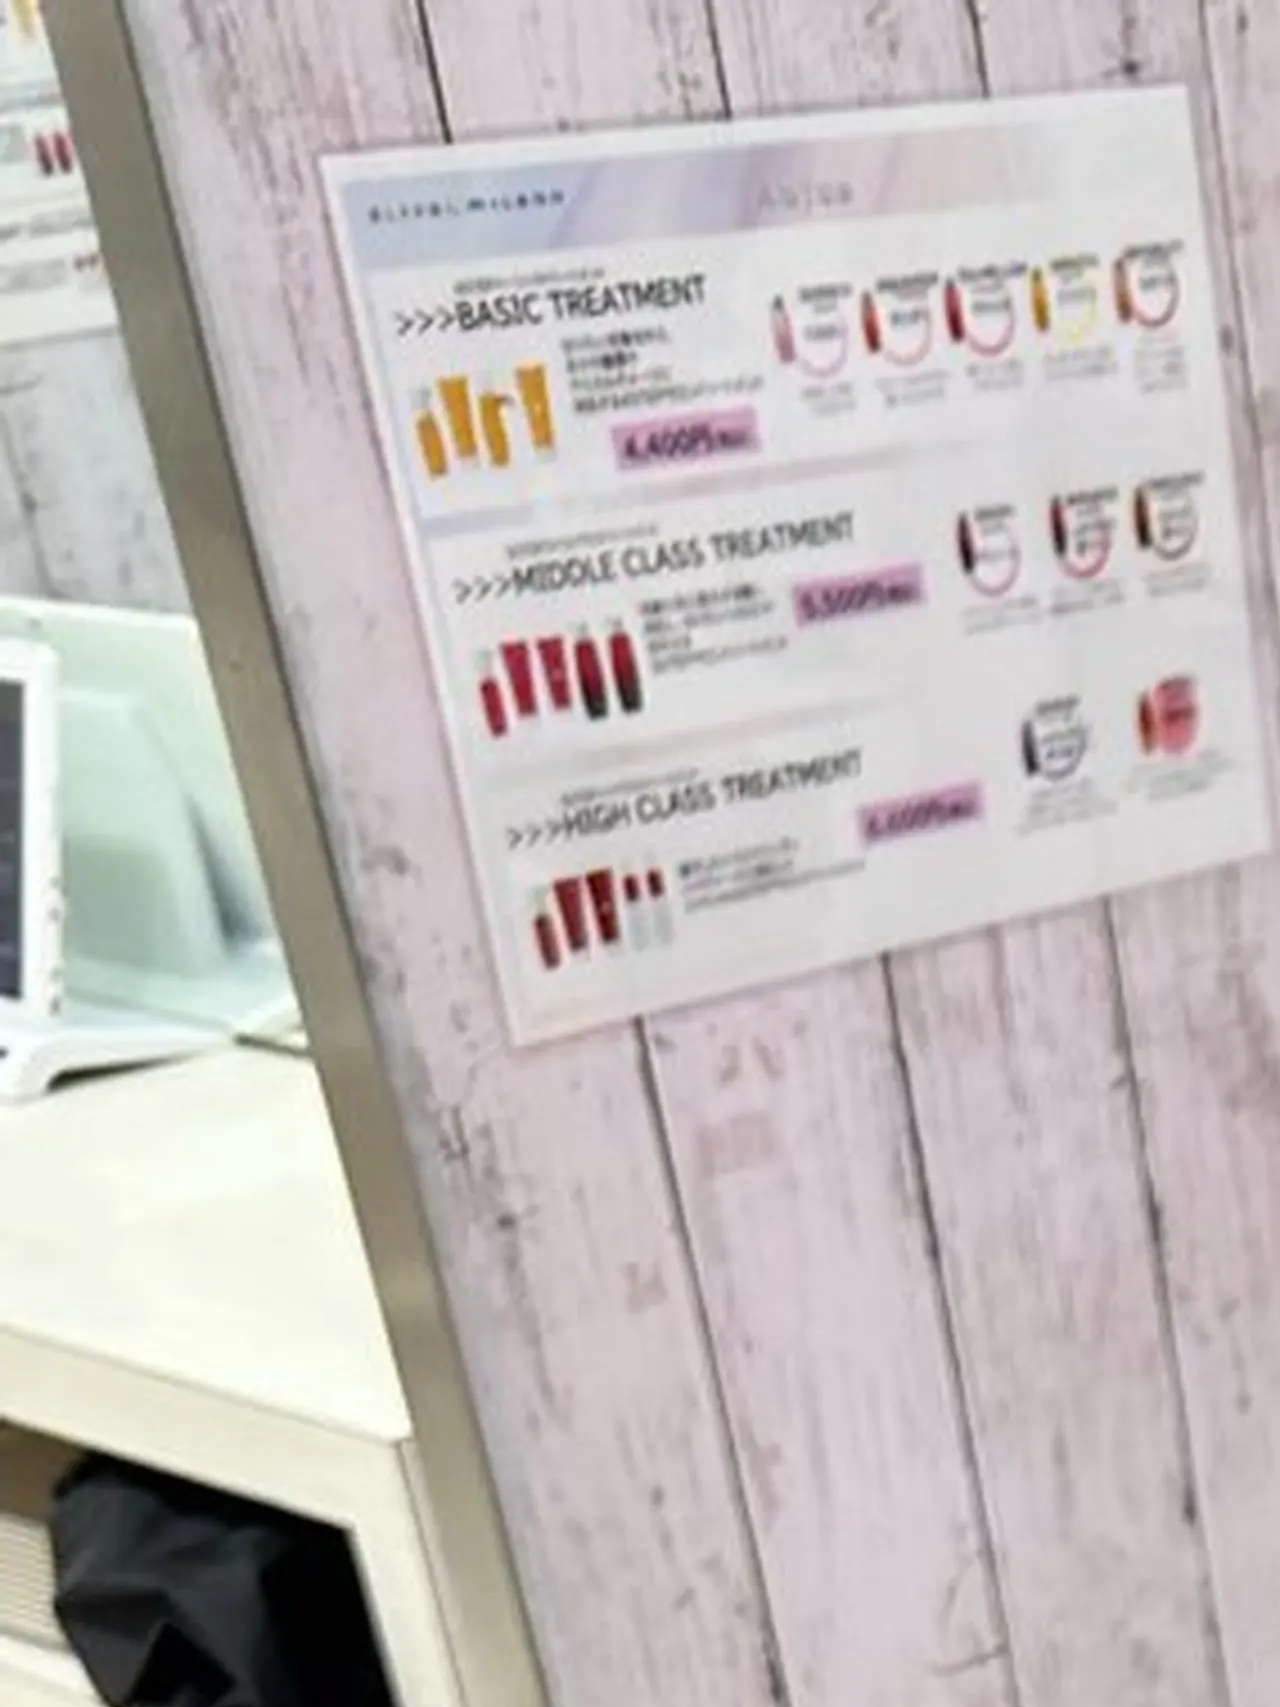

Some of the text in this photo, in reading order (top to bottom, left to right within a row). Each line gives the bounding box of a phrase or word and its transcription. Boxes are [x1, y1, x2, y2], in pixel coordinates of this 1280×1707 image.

[455, 294, 542, 331] BASIC
[553, 275, 705, 319] TREATMENT
[512, 553, 617, 594] MIDDLE
[622, 539, 702, 578] CLASS
[711, 513, 853, 561] TREATMENT
[564, 805, 632, 841] HIGH
[637, 786, 716, 822] CLASS
[721, 749, 862, 799] TREATMENT
